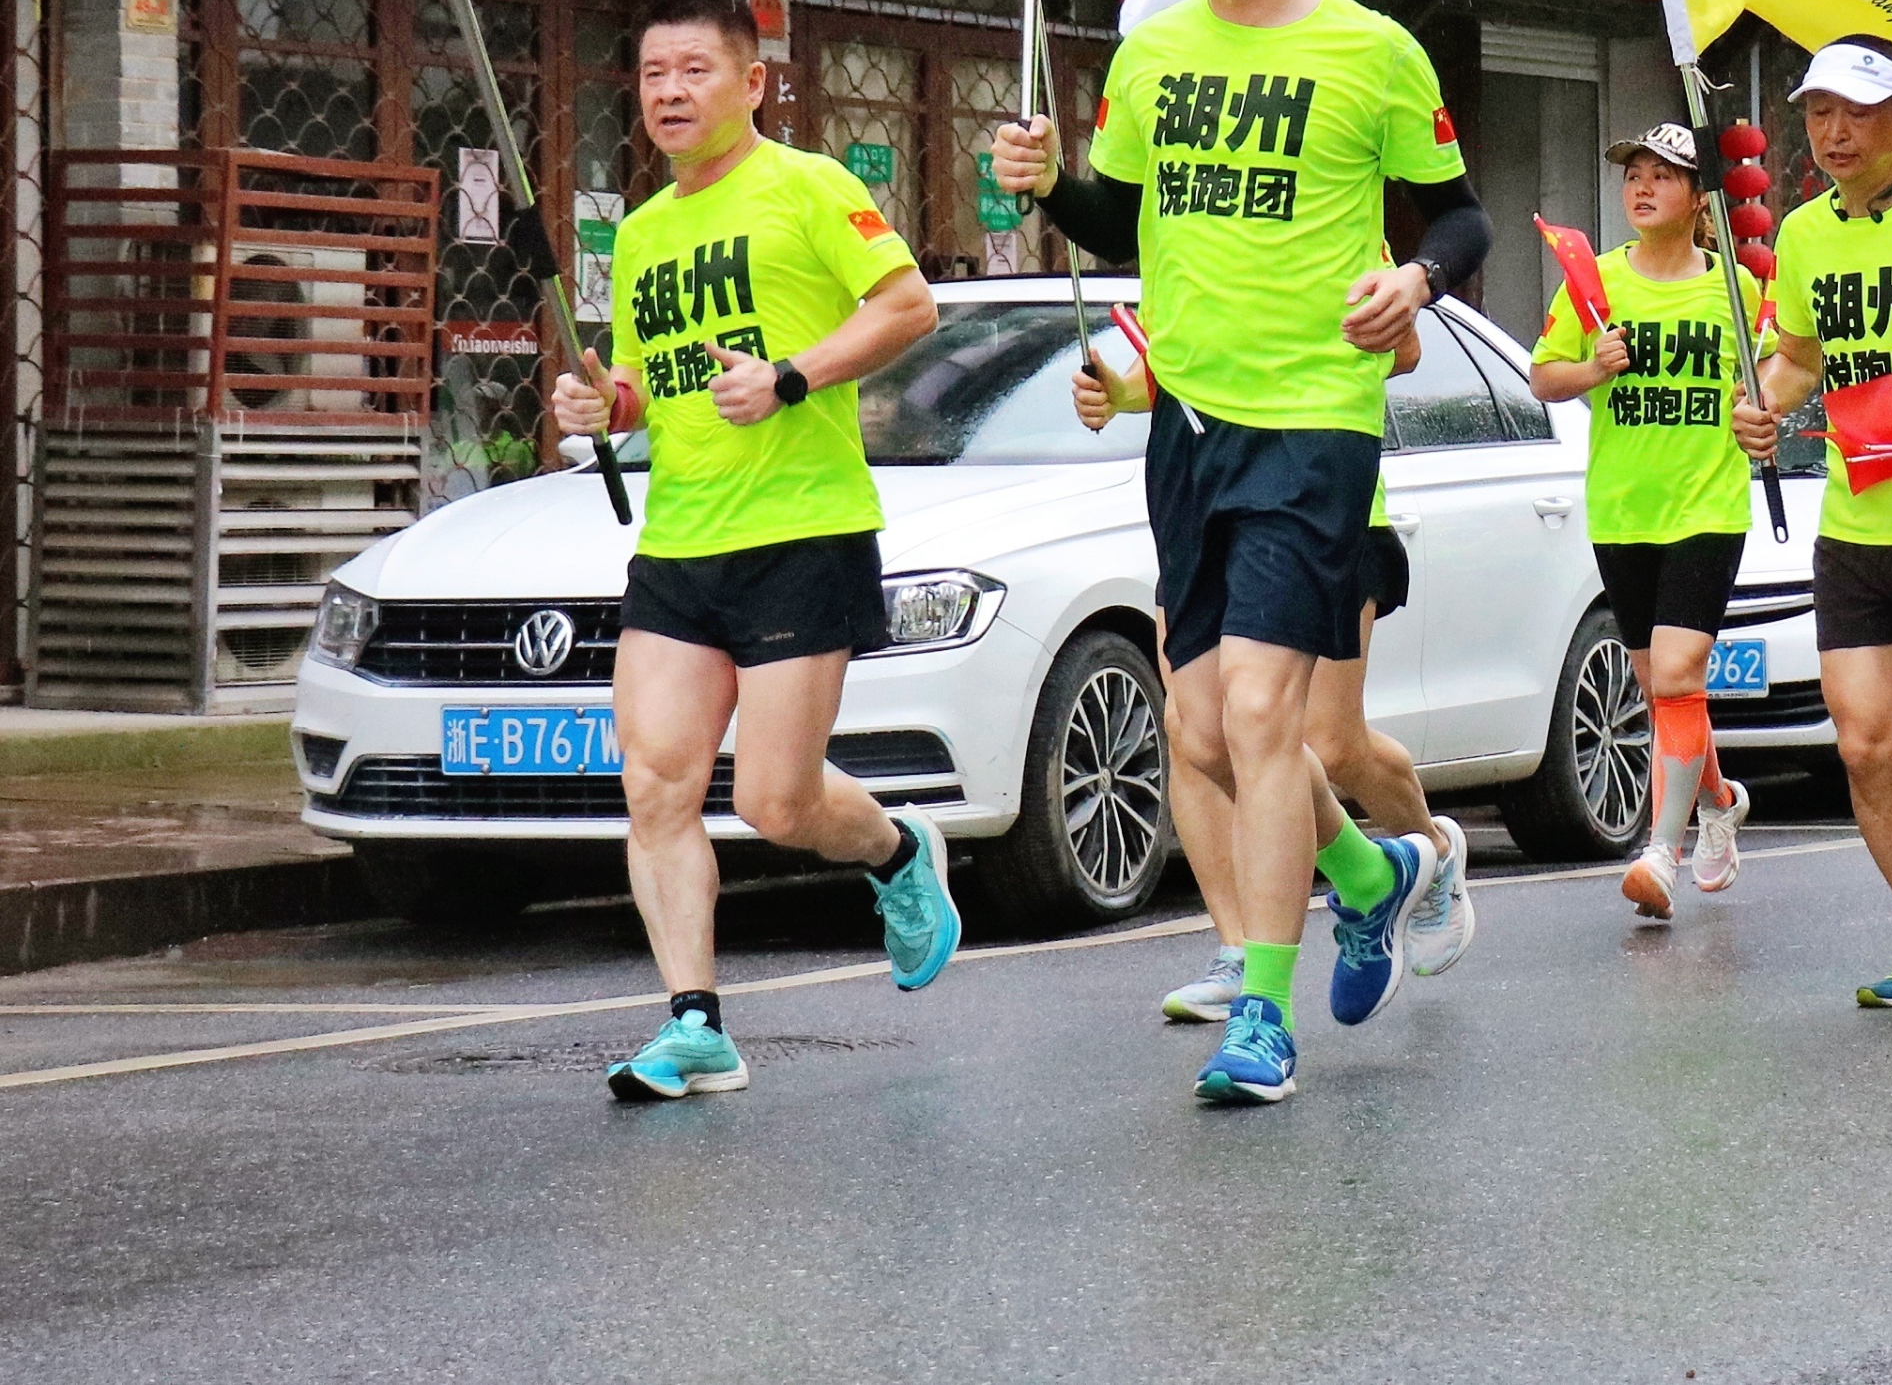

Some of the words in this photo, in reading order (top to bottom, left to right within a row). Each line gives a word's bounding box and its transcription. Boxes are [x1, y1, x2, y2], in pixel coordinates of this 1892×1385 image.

[1153, 72, 1317, 158] 湖州
[1157, 160, 1298, 222] 悦跑团
[631, 235, 757, 344] 湖州
[1606, 319, 1722, 380] 湖州
[1607, 385, 1722, 428] 悦跑团
